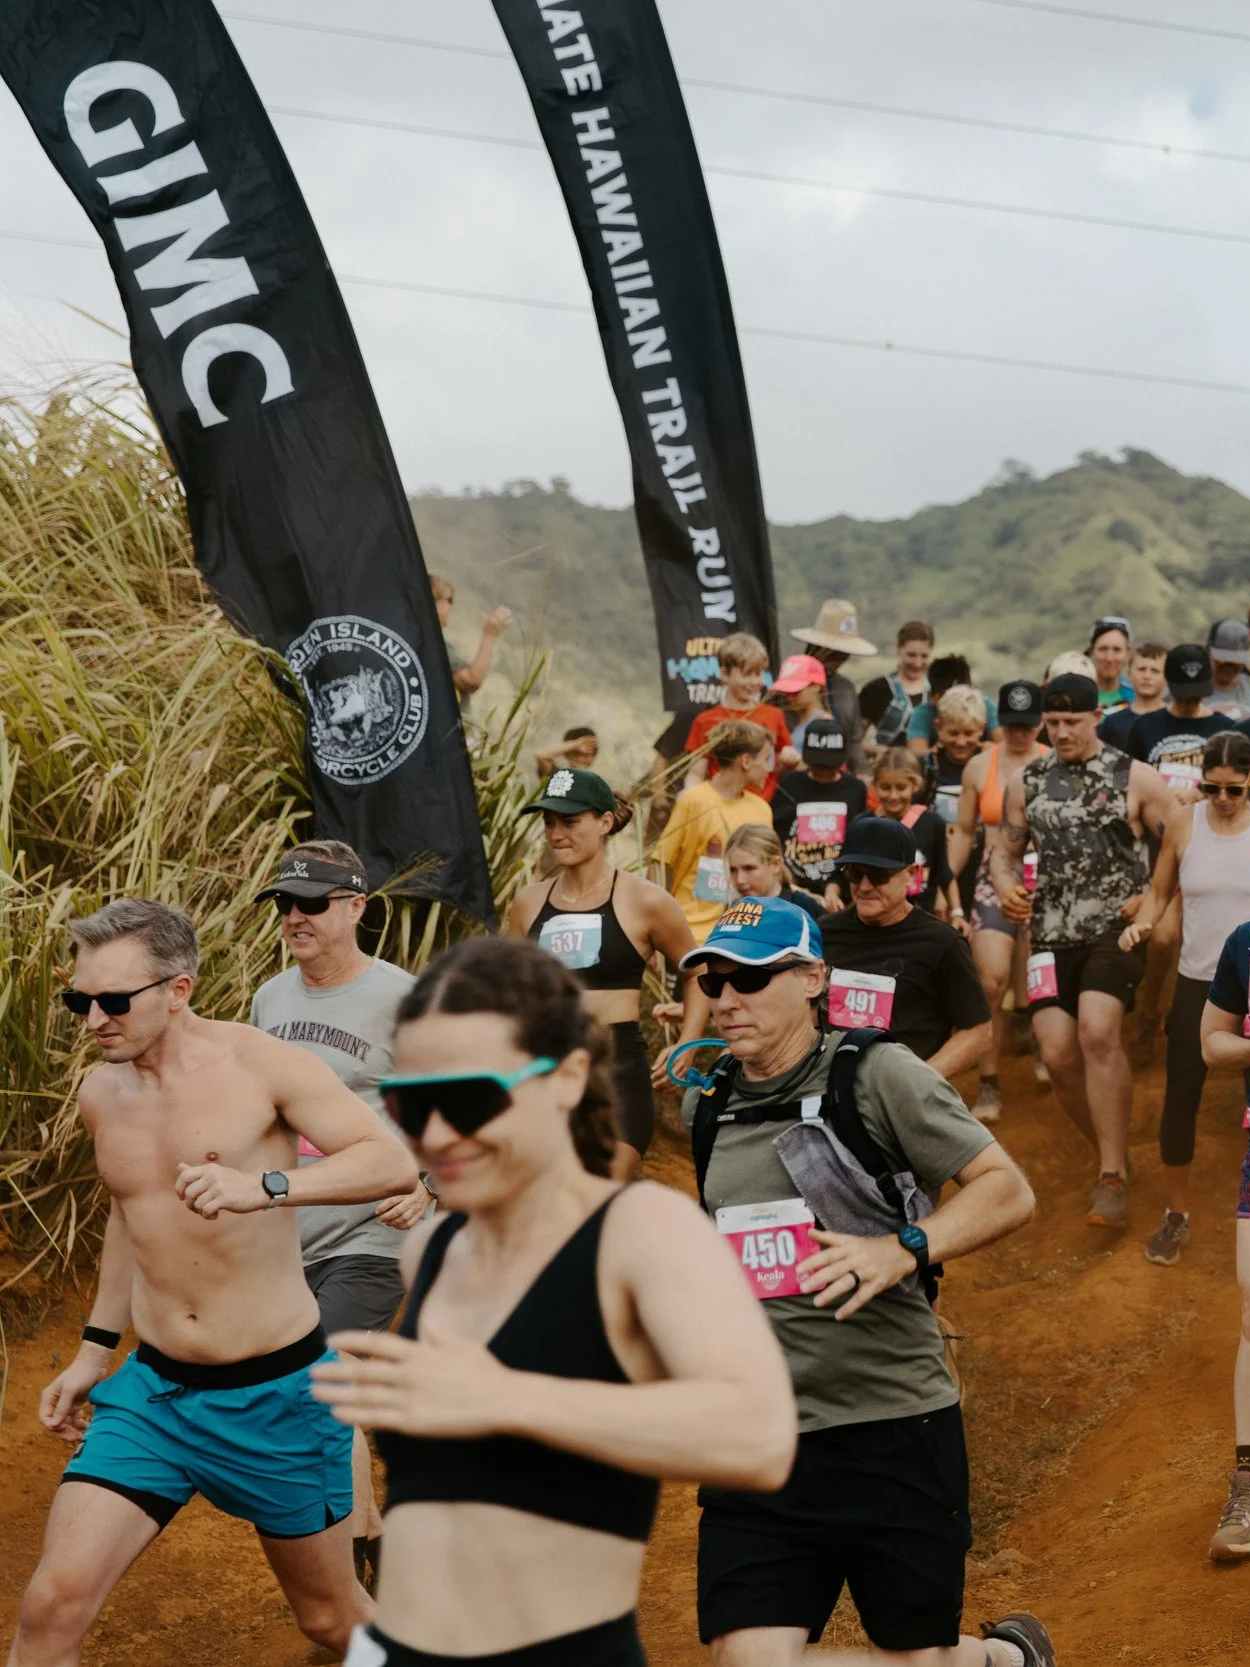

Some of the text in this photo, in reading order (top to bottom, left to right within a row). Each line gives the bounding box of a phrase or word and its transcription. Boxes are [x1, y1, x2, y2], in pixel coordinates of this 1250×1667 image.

[63, 60, 295, 428] GIMC
[537, 0, 737, 624] ATE HAWAIIAN TRAIL RUN
[329, 623, 412, 668] ISLAND
[398, 694, 422, 744] CLUB
[551, 931, 585, 953] 537
[845, 989, 877, 1014] 491
[287, 1020, 372, 1064] MARYMOUNT
[742, 1229, 796, 1270] 450
[757, 1269, 785, 1281] Keala
